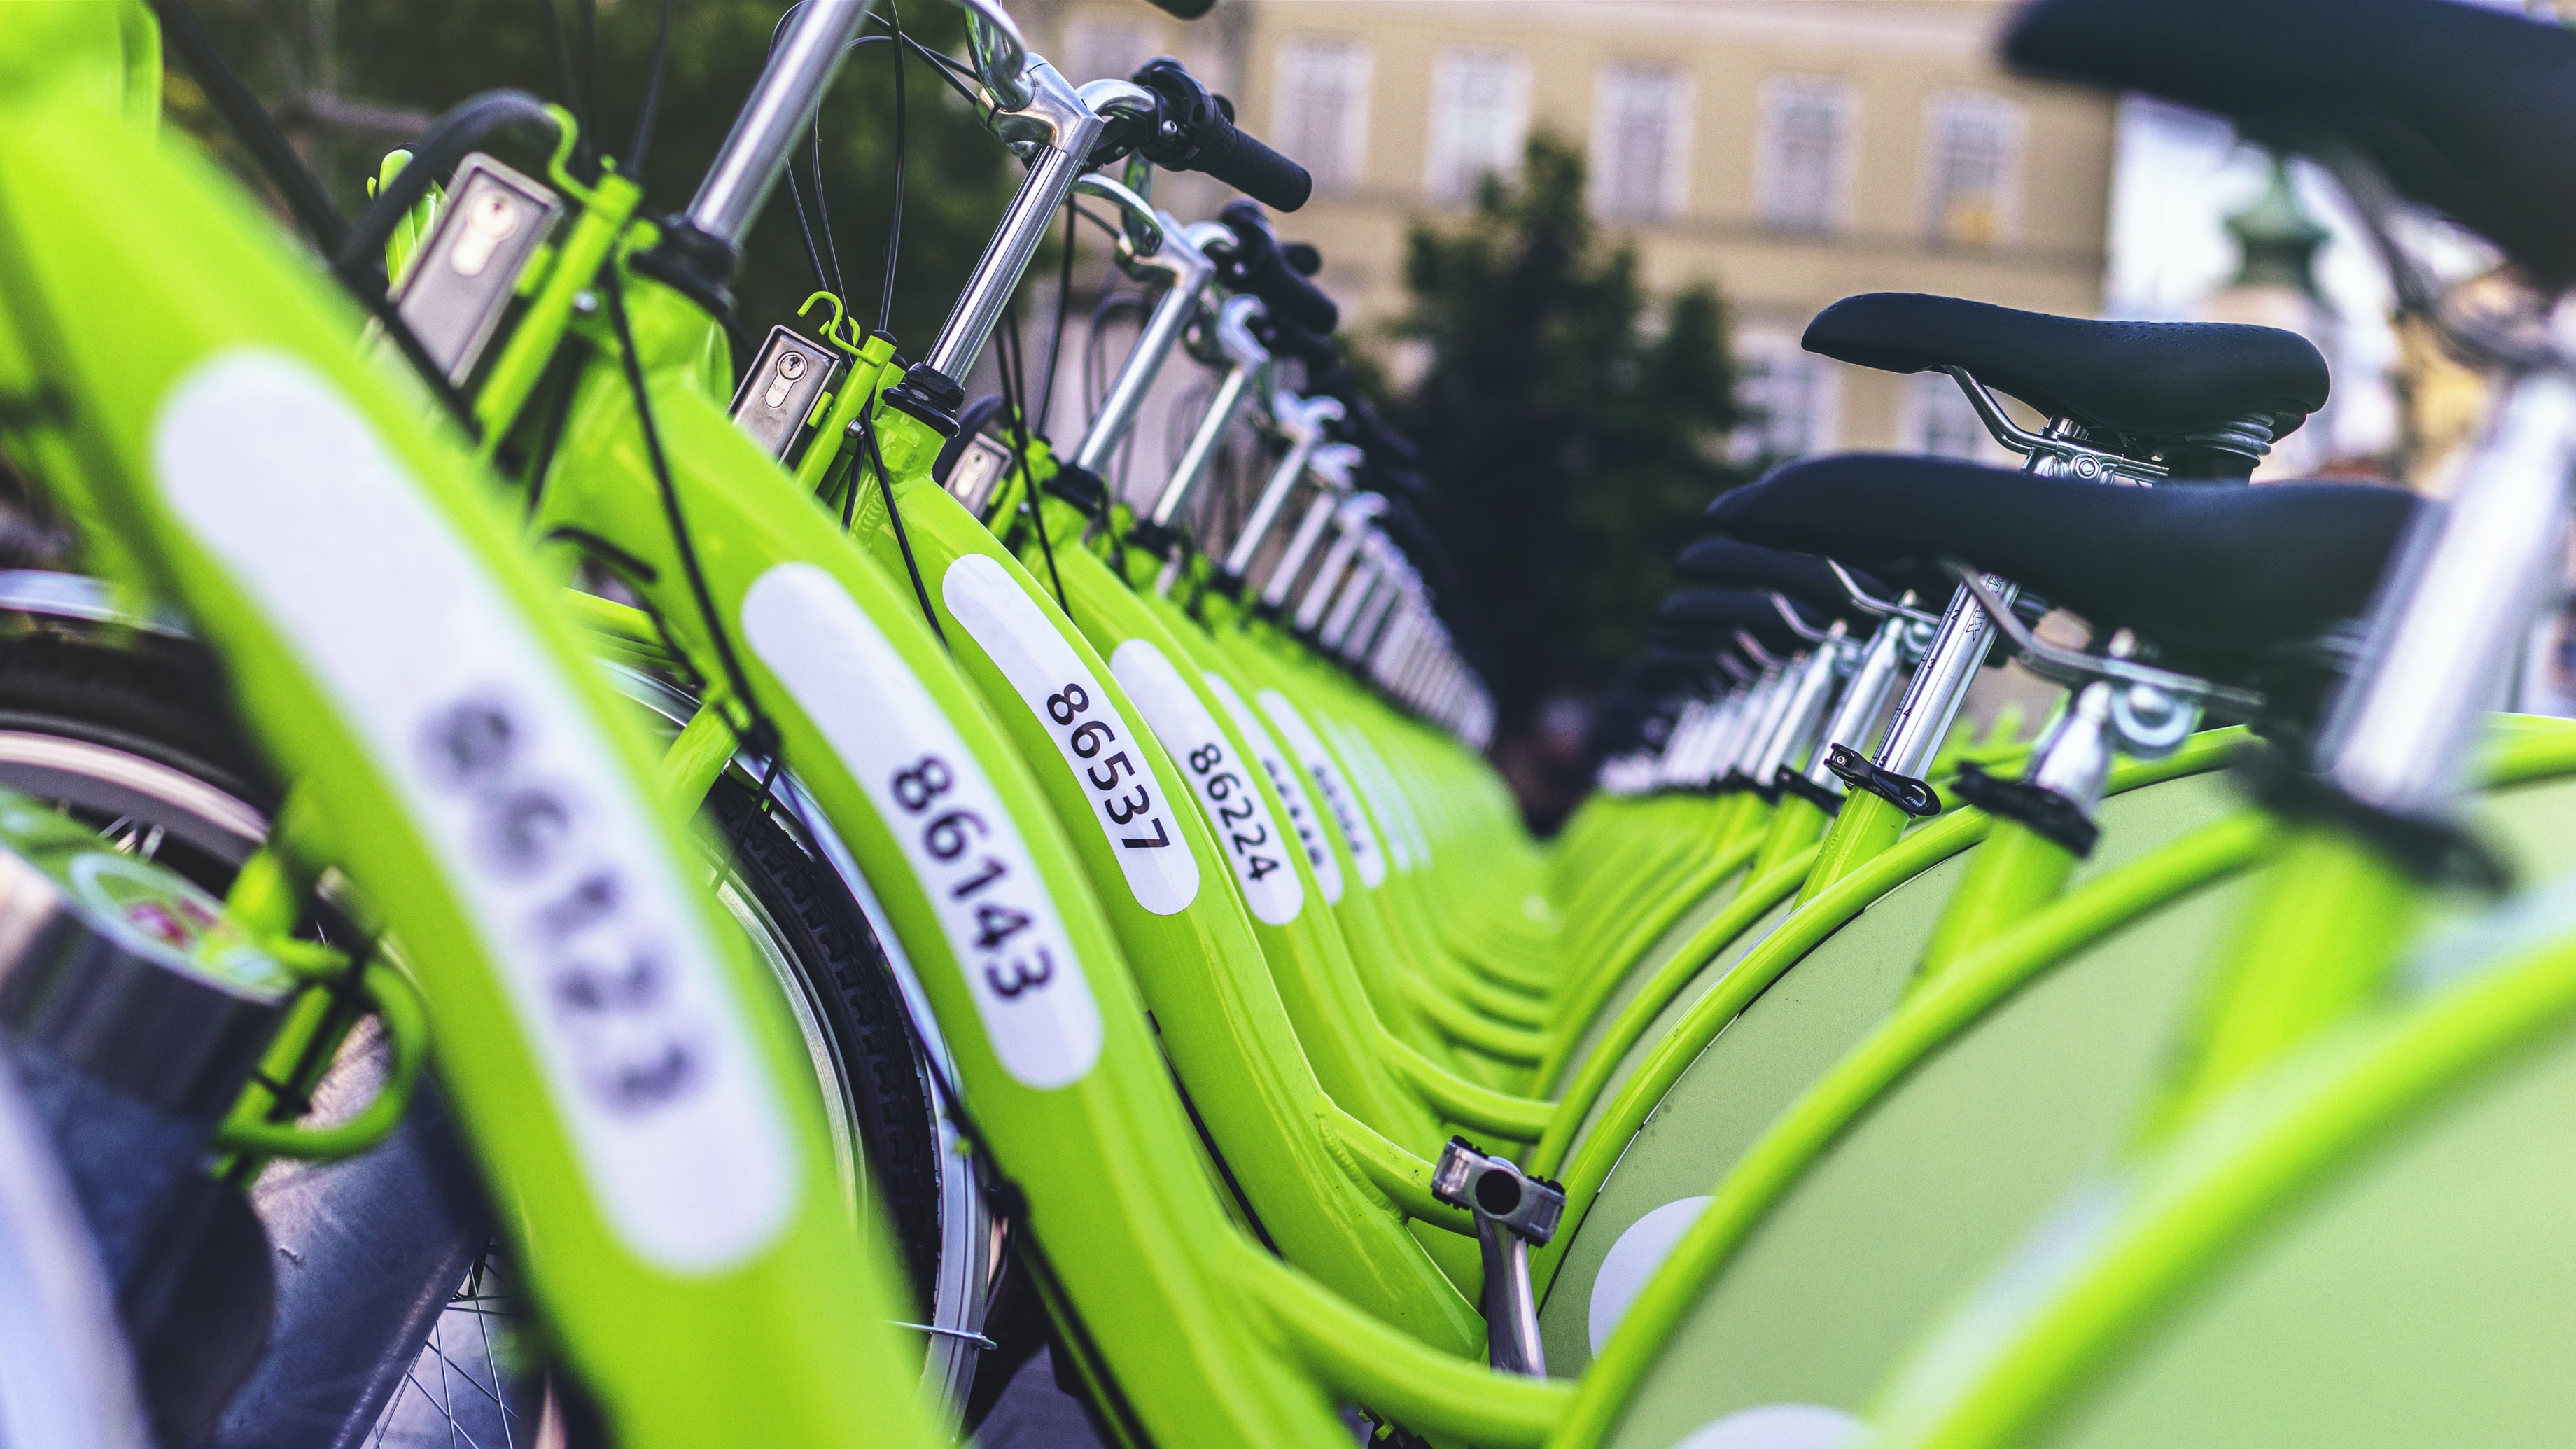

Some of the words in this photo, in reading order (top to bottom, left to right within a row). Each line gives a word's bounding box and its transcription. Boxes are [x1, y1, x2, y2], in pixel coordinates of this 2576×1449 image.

[1951, 610, 1961, 621] 2
[1927, 658, 1936, 669] 3
[1903, 708, 1912, 718] 4
[1047, 683, 1170, 848] 86537
[1879, 755, 1888, 767] 5
[1189, 743, 1280, 881] 86224
[891, 755, 1056, 1002] 86143
